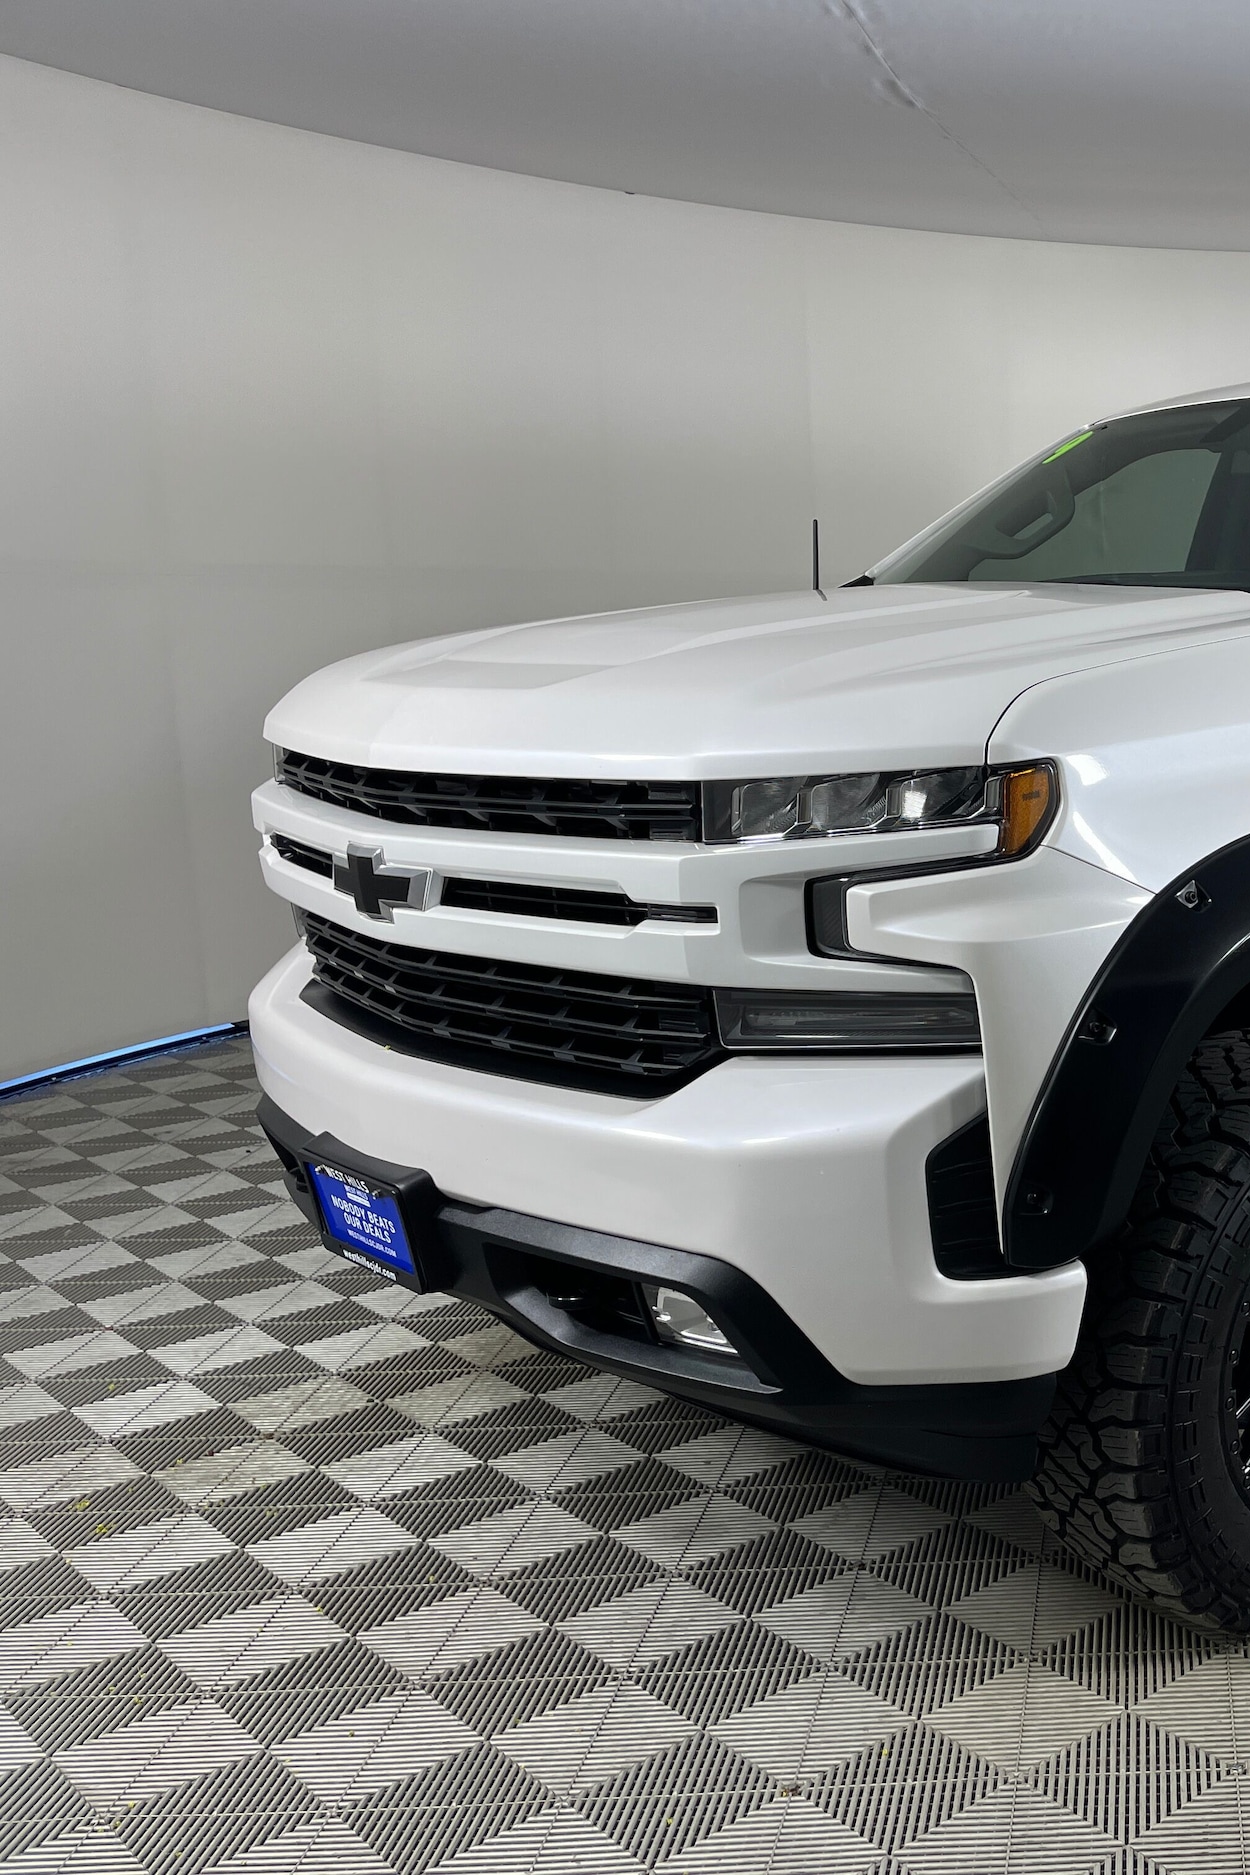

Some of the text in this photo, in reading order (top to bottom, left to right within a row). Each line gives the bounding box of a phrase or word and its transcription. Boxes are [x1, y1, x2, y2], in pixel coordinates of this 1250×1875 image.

[344, 1174, 370, 1194] HILLS
[331, 1194, 396, 1234] NOBODY BEATS
[343, 1211, 392, 1244] OUR DEALS
